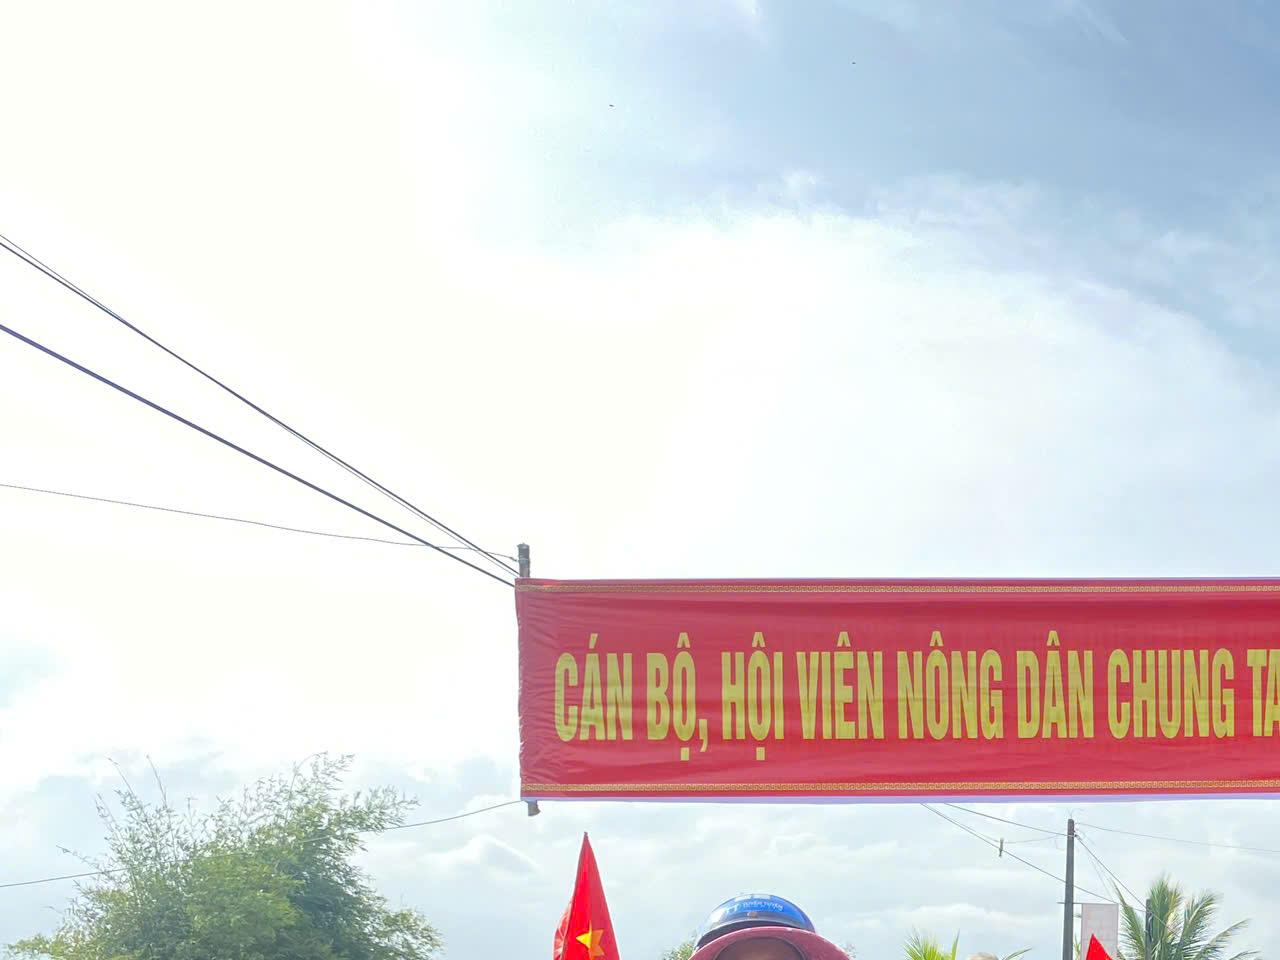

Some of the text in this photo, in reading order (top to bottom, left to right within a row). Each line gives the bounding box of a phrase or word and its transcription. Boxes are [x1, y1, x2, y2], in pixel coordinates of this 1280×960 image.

[554, 631, 633, 742] CÁN
[646, 630, 709, 762] BỘ,
[721, 629, 784, 763] HỘI
[794, 629, 884, 741] VIÊN
[896, 628, 1004, 741] NÔNG
[1016, 628, 1094, 741] DÂN
[1107, 647, 1236, 741] CHUNG
